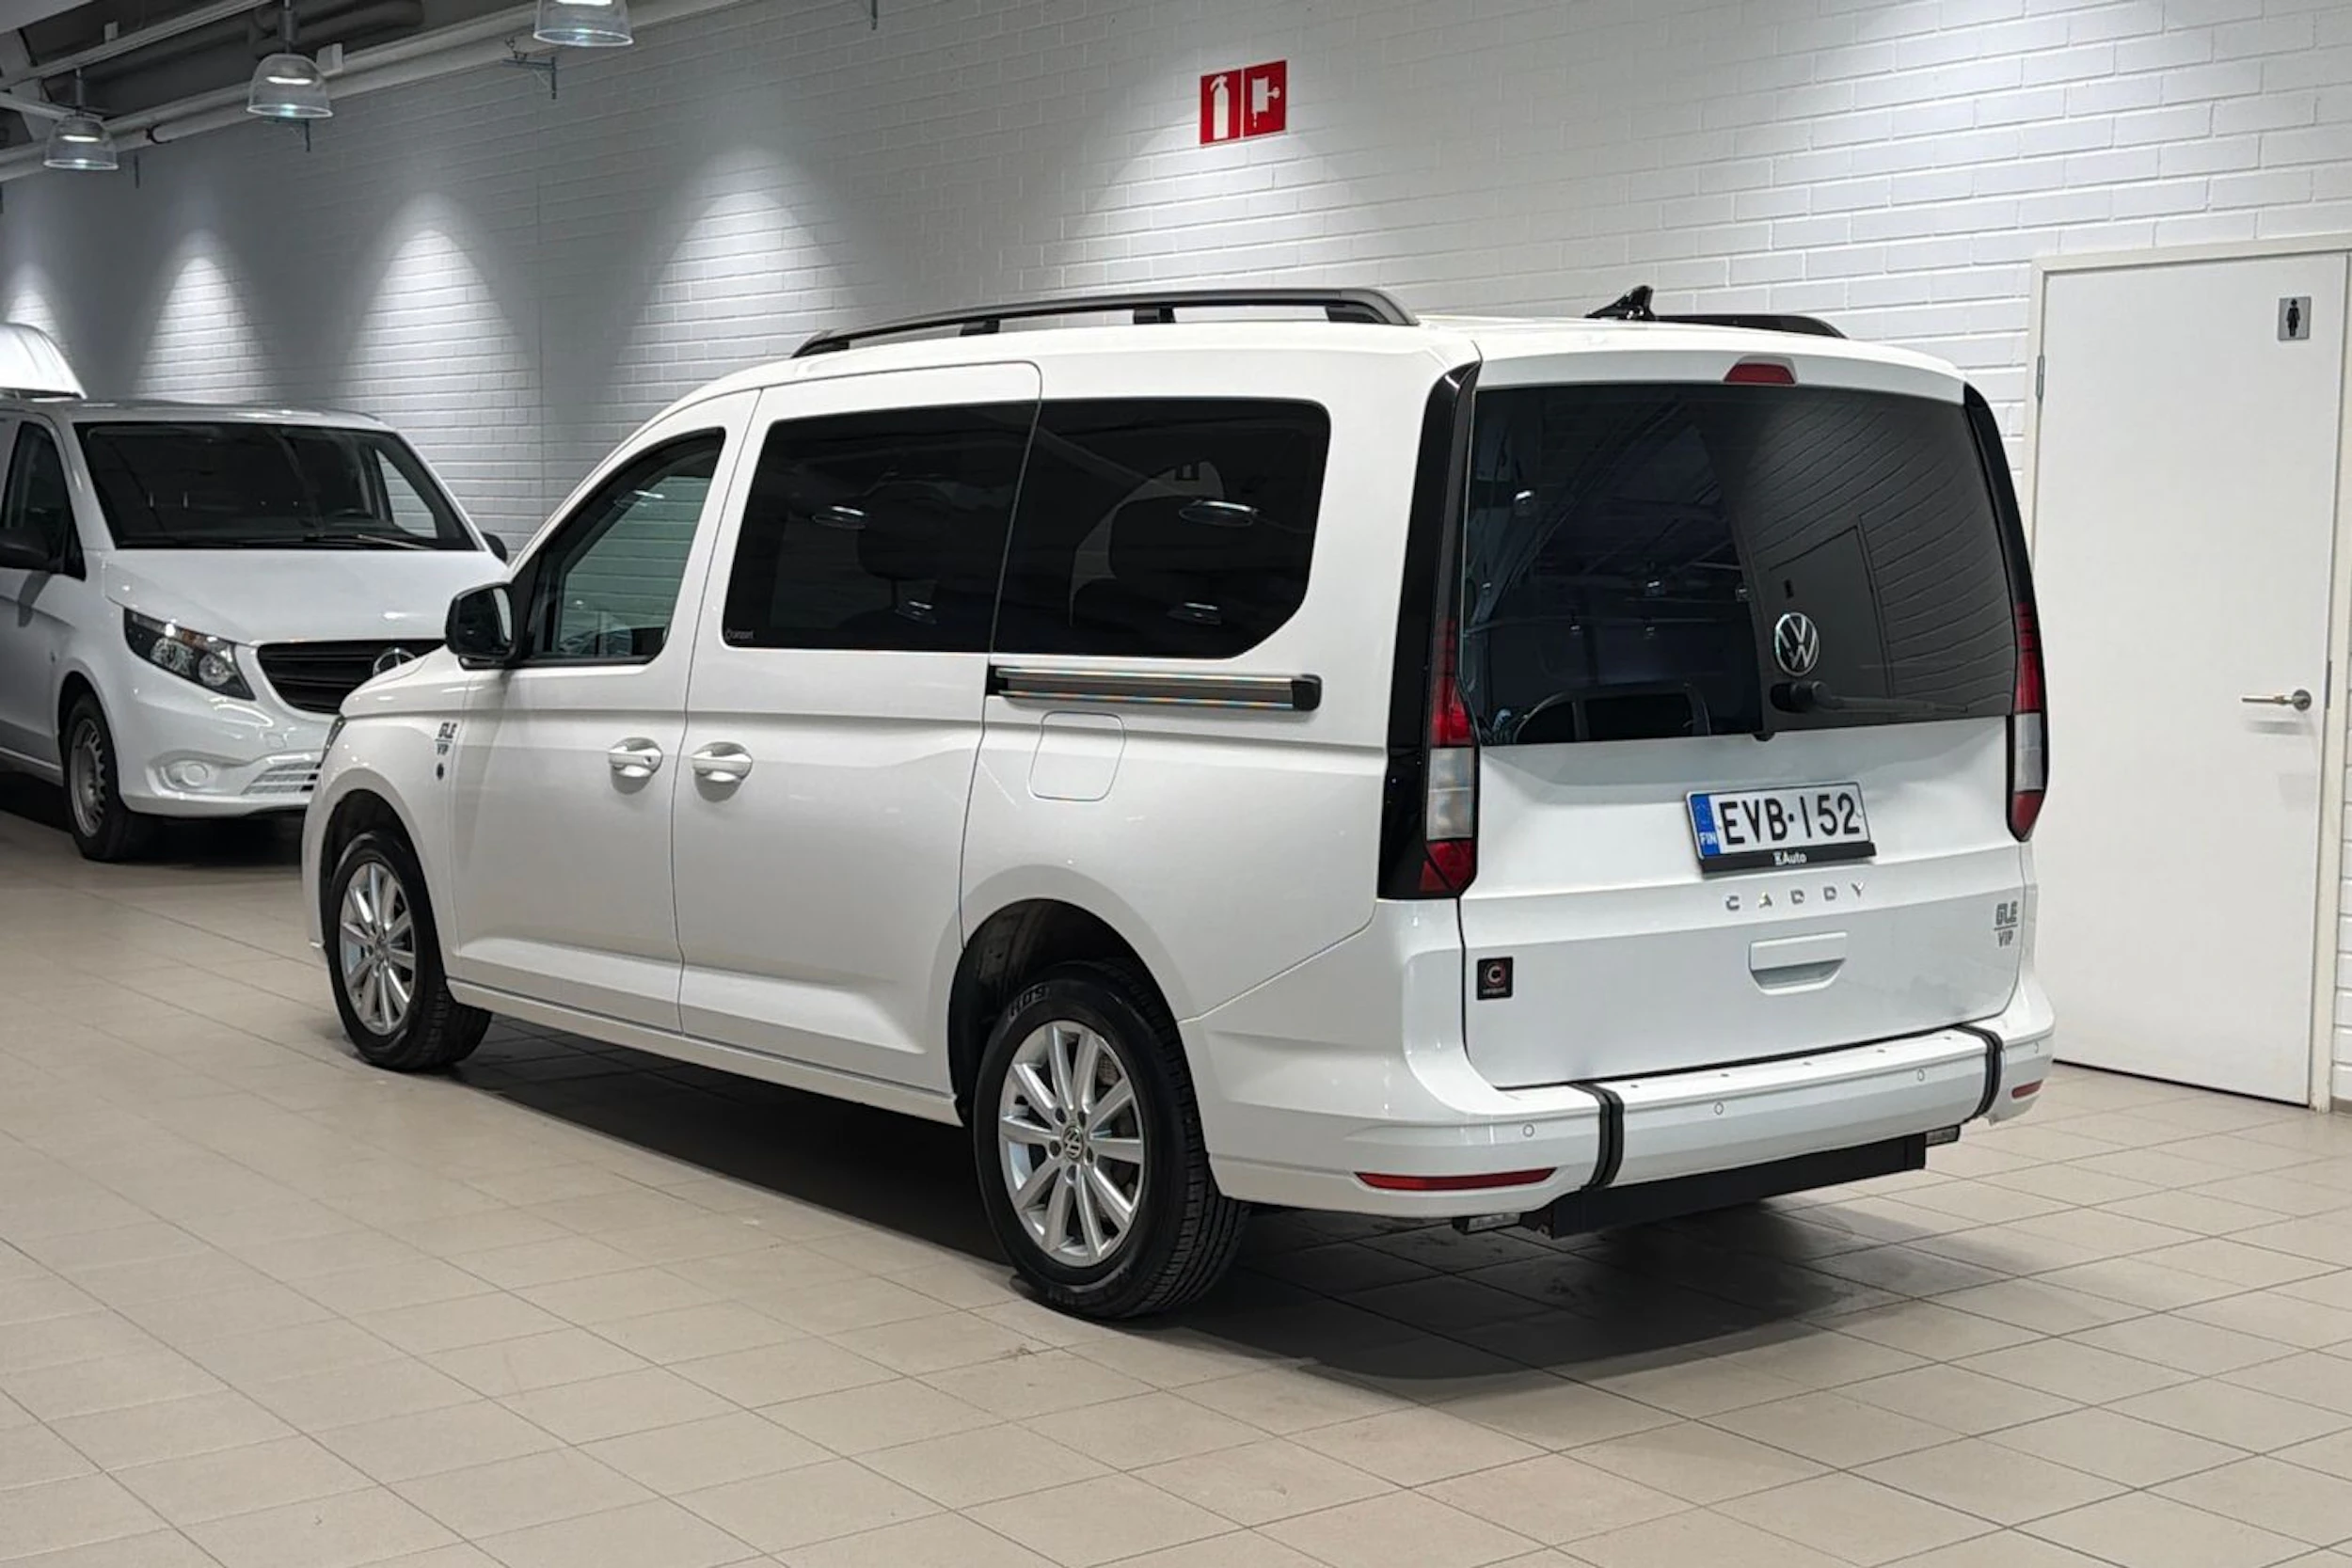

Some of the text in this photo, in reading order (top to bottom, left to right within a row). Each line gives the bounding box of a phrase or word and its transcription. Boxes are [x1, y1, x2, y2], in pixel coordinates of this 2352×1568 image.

[1699, 832, 1718, 846] FIN
[1725, 881, 1865, 911] CADDY
[1997, 929, 2013, 947] VIP
